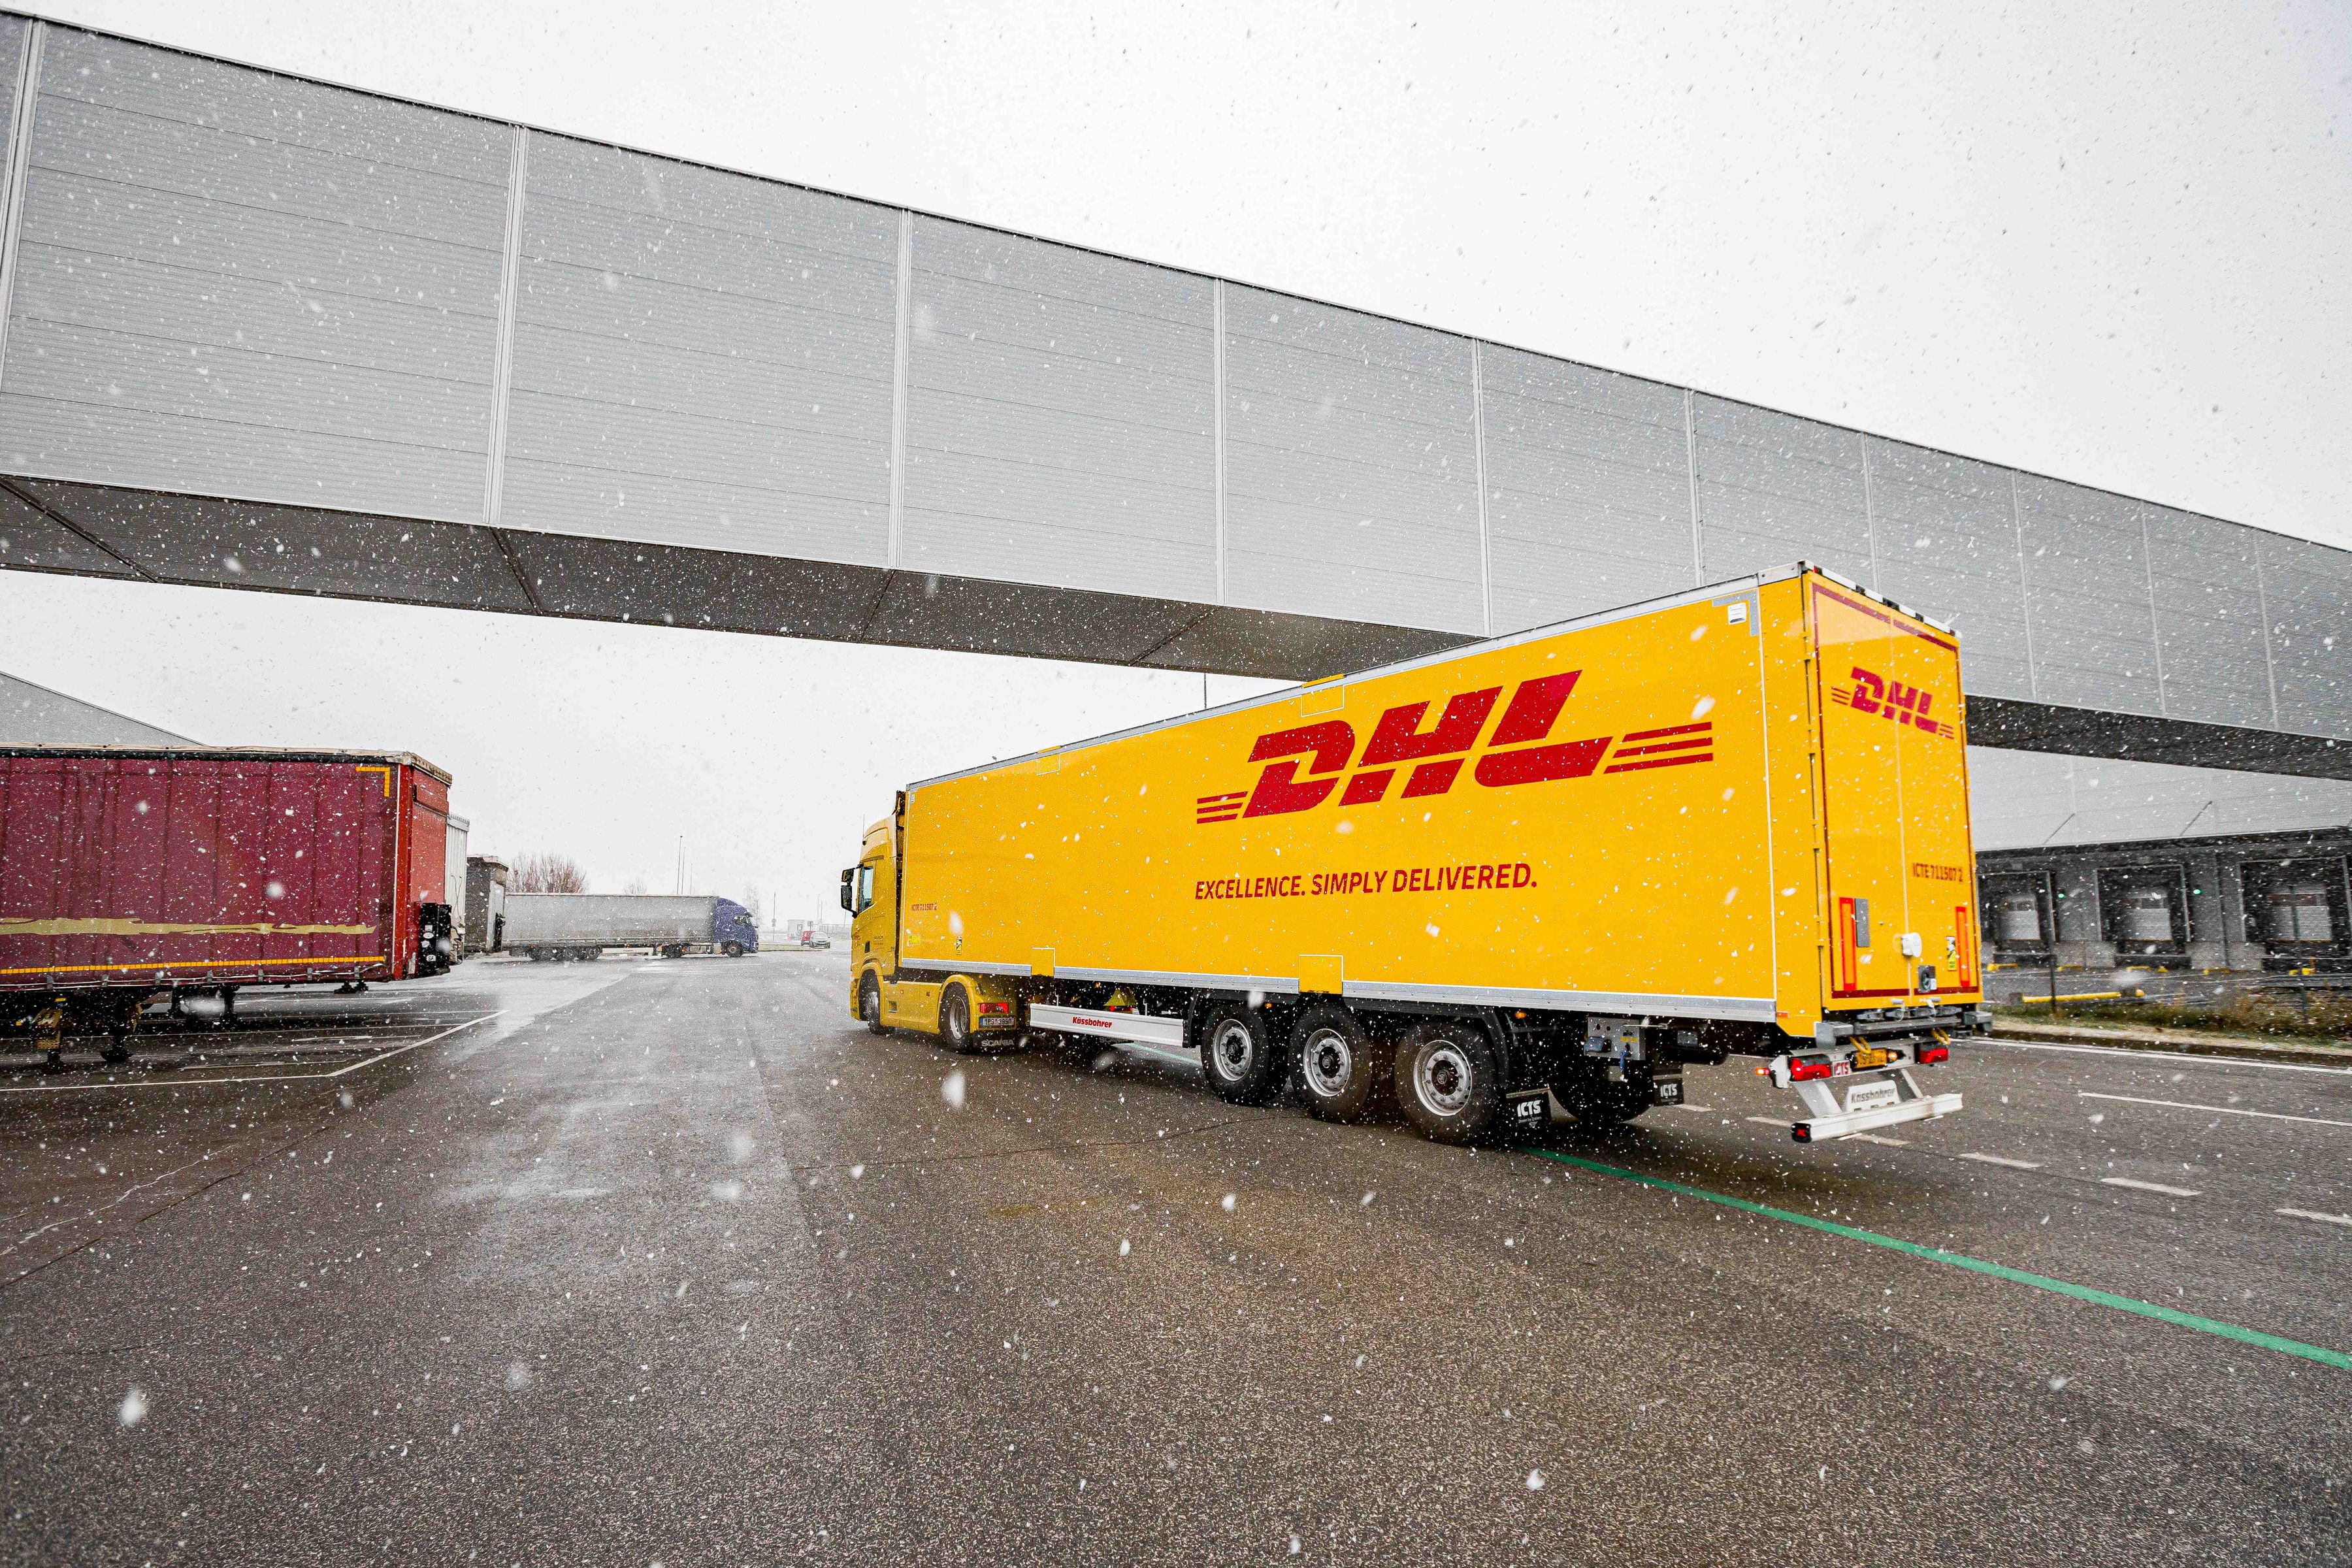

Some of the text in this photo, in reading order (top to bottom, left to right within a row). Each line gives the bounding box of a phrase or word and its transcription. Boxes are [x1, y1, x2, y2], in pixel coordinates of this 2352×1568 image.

[1851, 667, 1939, 734] DHL
[1243, 670, 1613, 818] DHL
[1195, 863, 1537, 900] EXCELLENCE. SIMPLY DELIVERED.
[1072, 1017, 1113, 1028] Kässbohrer
[1660, 1083, 1678, 1098] ICTS
[1517, 1100, 1541, 1117] ICTS
